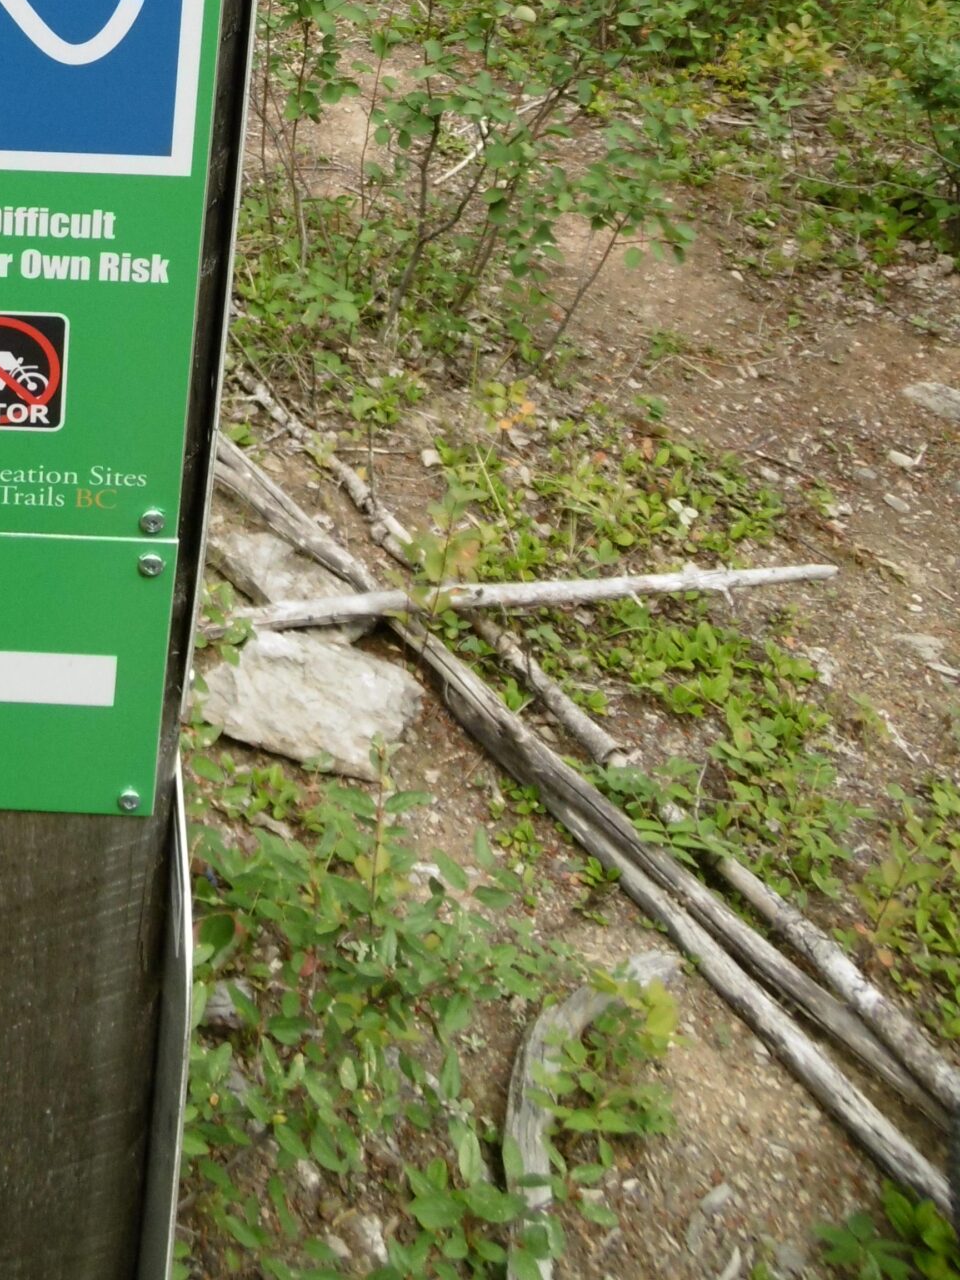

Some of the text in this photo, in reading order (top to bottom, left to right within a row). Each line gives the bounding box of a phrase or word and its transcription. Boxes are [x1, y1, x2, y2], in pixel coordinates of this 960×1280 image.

[20, 249, 90, 281] Own
[98, 252, 170, 283] Risk
[88, 465, 148, 488] Sites
[75, 488, 118, 510] BC
